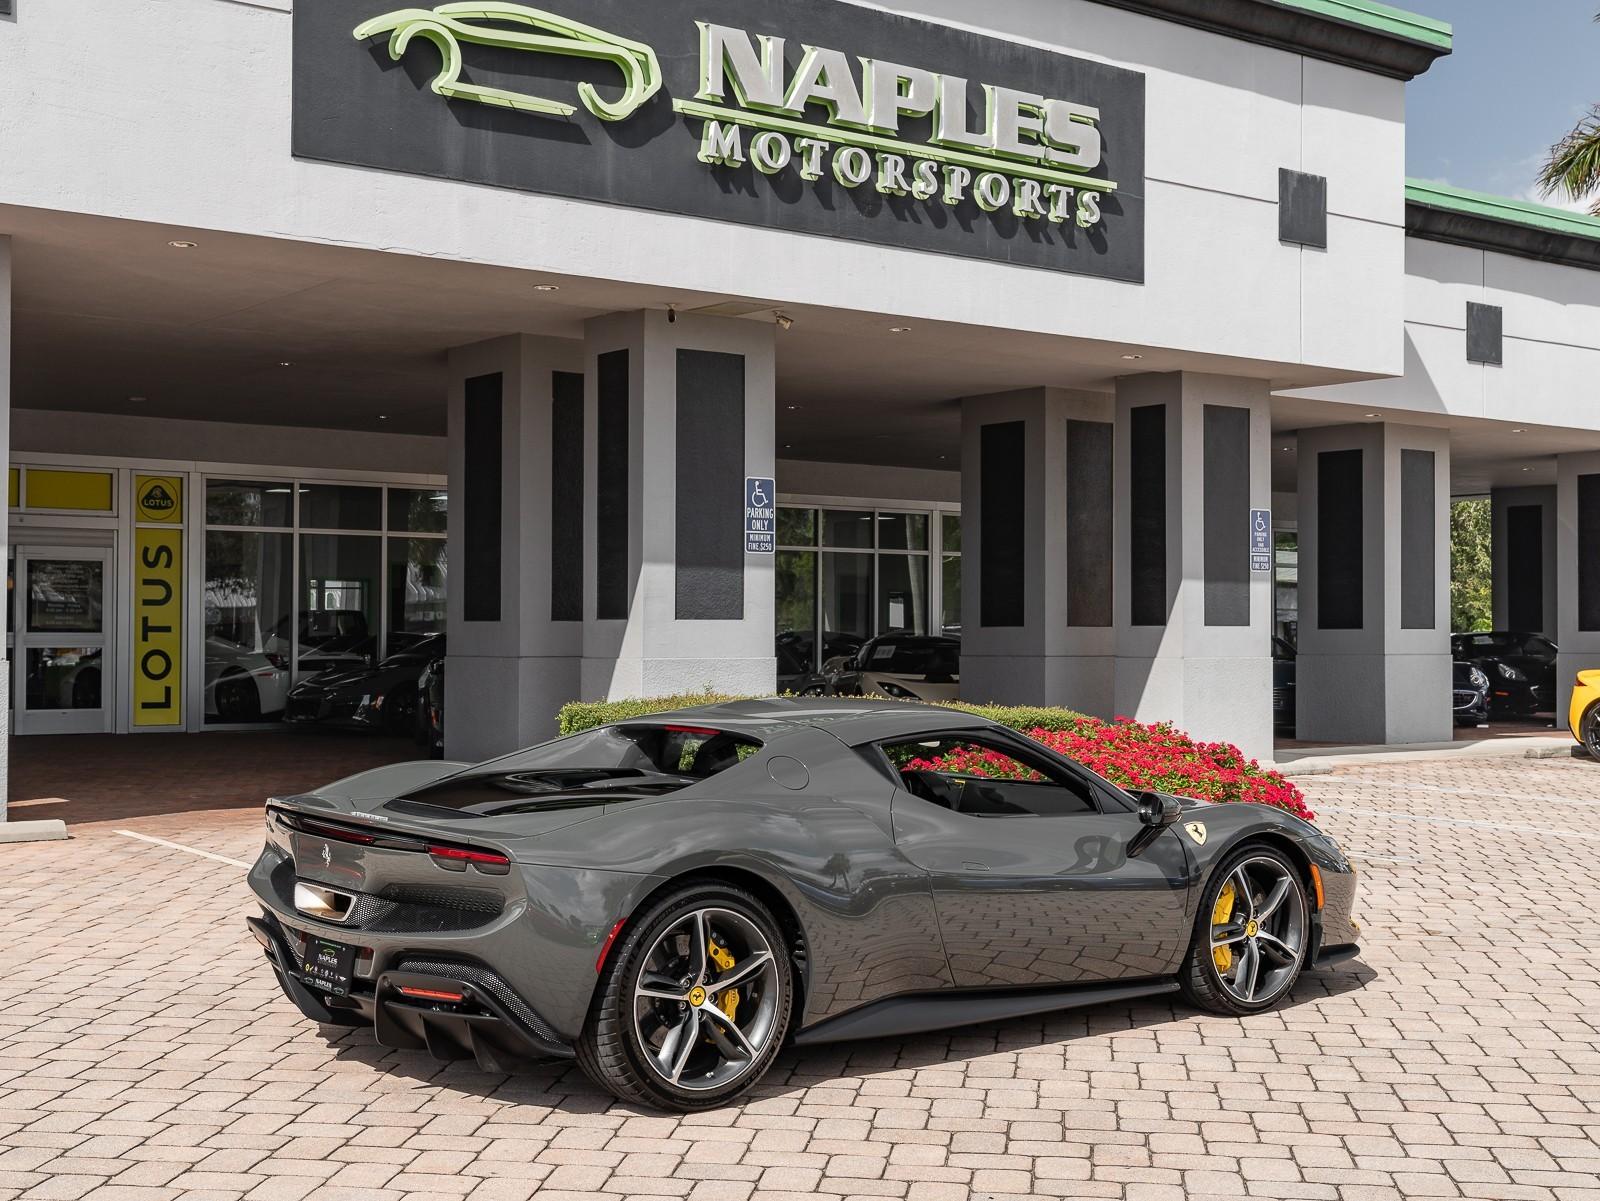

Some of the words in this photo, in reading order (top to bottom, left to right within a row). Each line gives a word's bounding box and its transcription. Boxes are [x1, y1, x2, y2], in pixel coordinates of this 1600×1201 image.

[695, 20, 1101, 171] NAPLES
[697, 119, 1101, 228] MOTORSPORTS
[143, 498, 173, 507] LOTUS
[746, 507, 774, 519] PARKING
[752, 519, 768, 530] ONLY
[749, 533, 771, 542] MINIMUM
[141, 544, 173, 709] LOTUS
[317, 953, 338, 965] NAPLES
